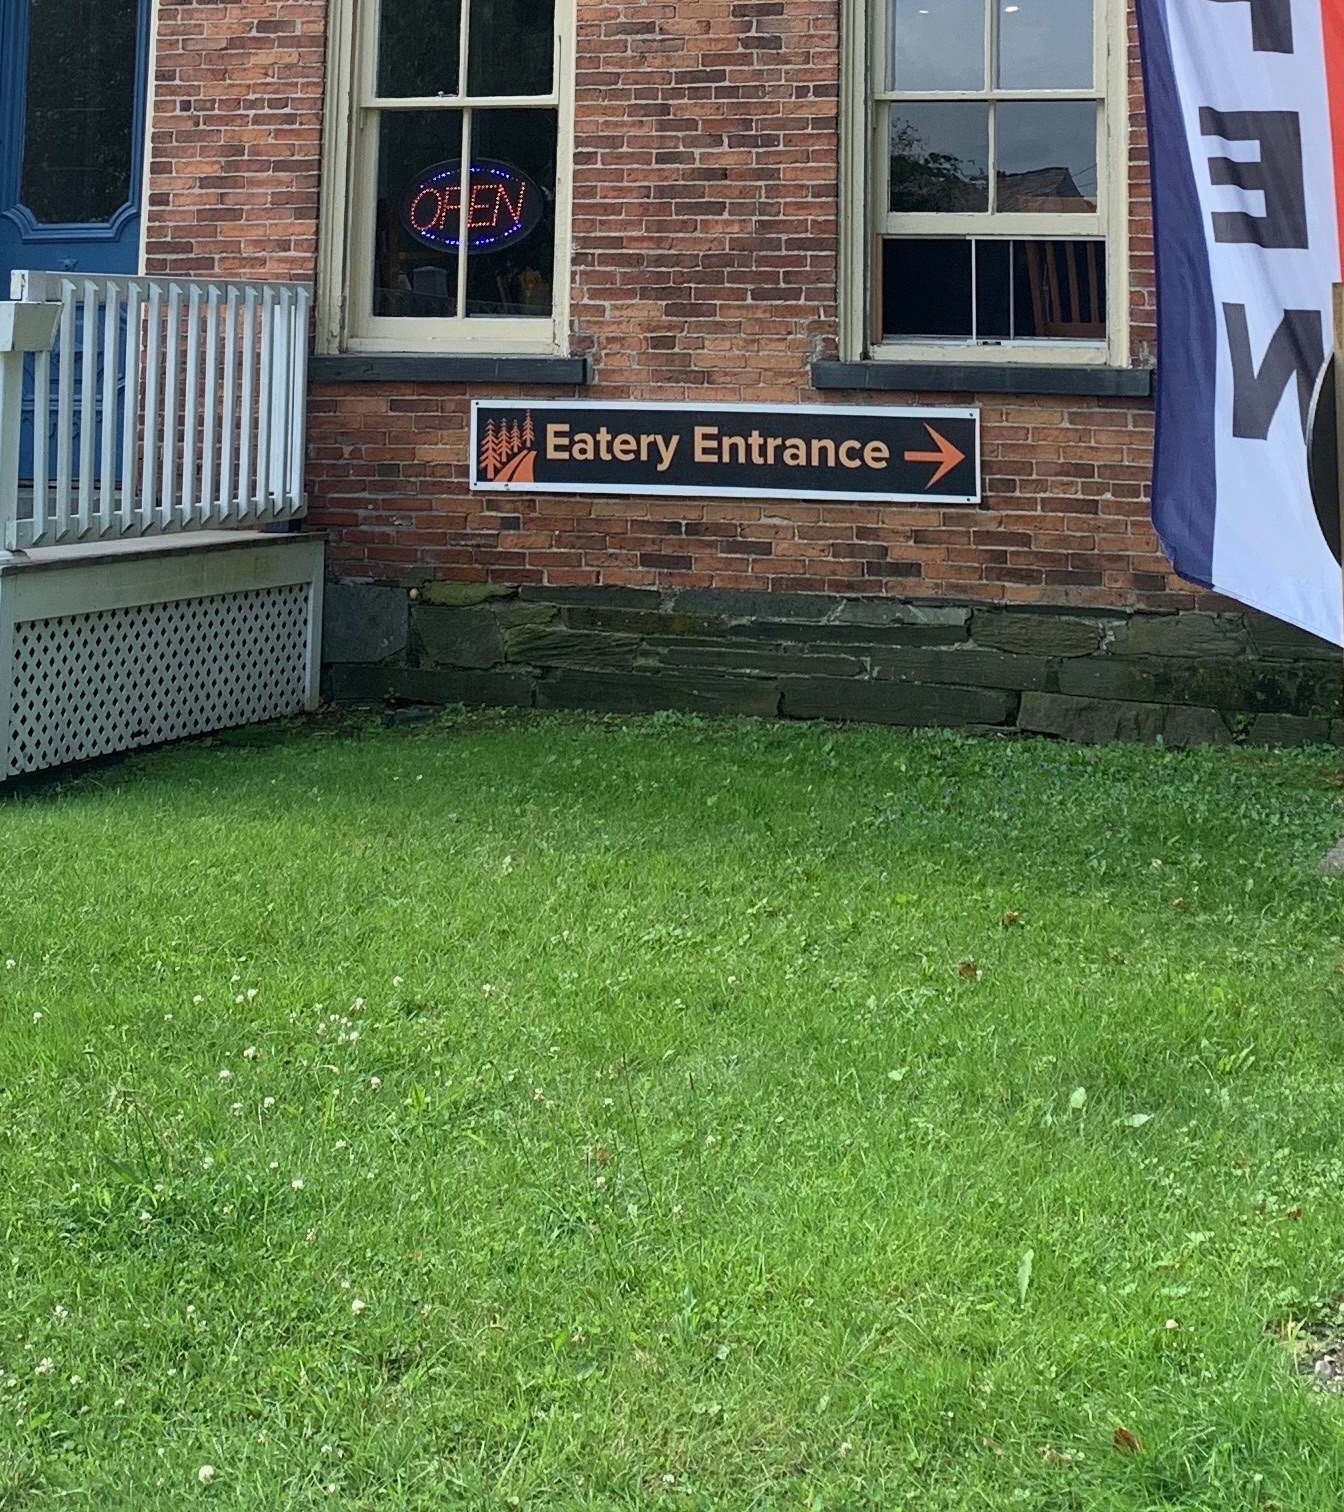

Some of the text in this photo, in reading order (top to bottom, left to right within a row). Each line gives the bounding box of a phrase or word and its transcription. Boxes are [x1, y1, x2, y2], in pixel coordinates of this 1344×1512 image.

[409, 181, 527, 231] OPEN
[545, 422, 891, 472] Eatery Entrance
